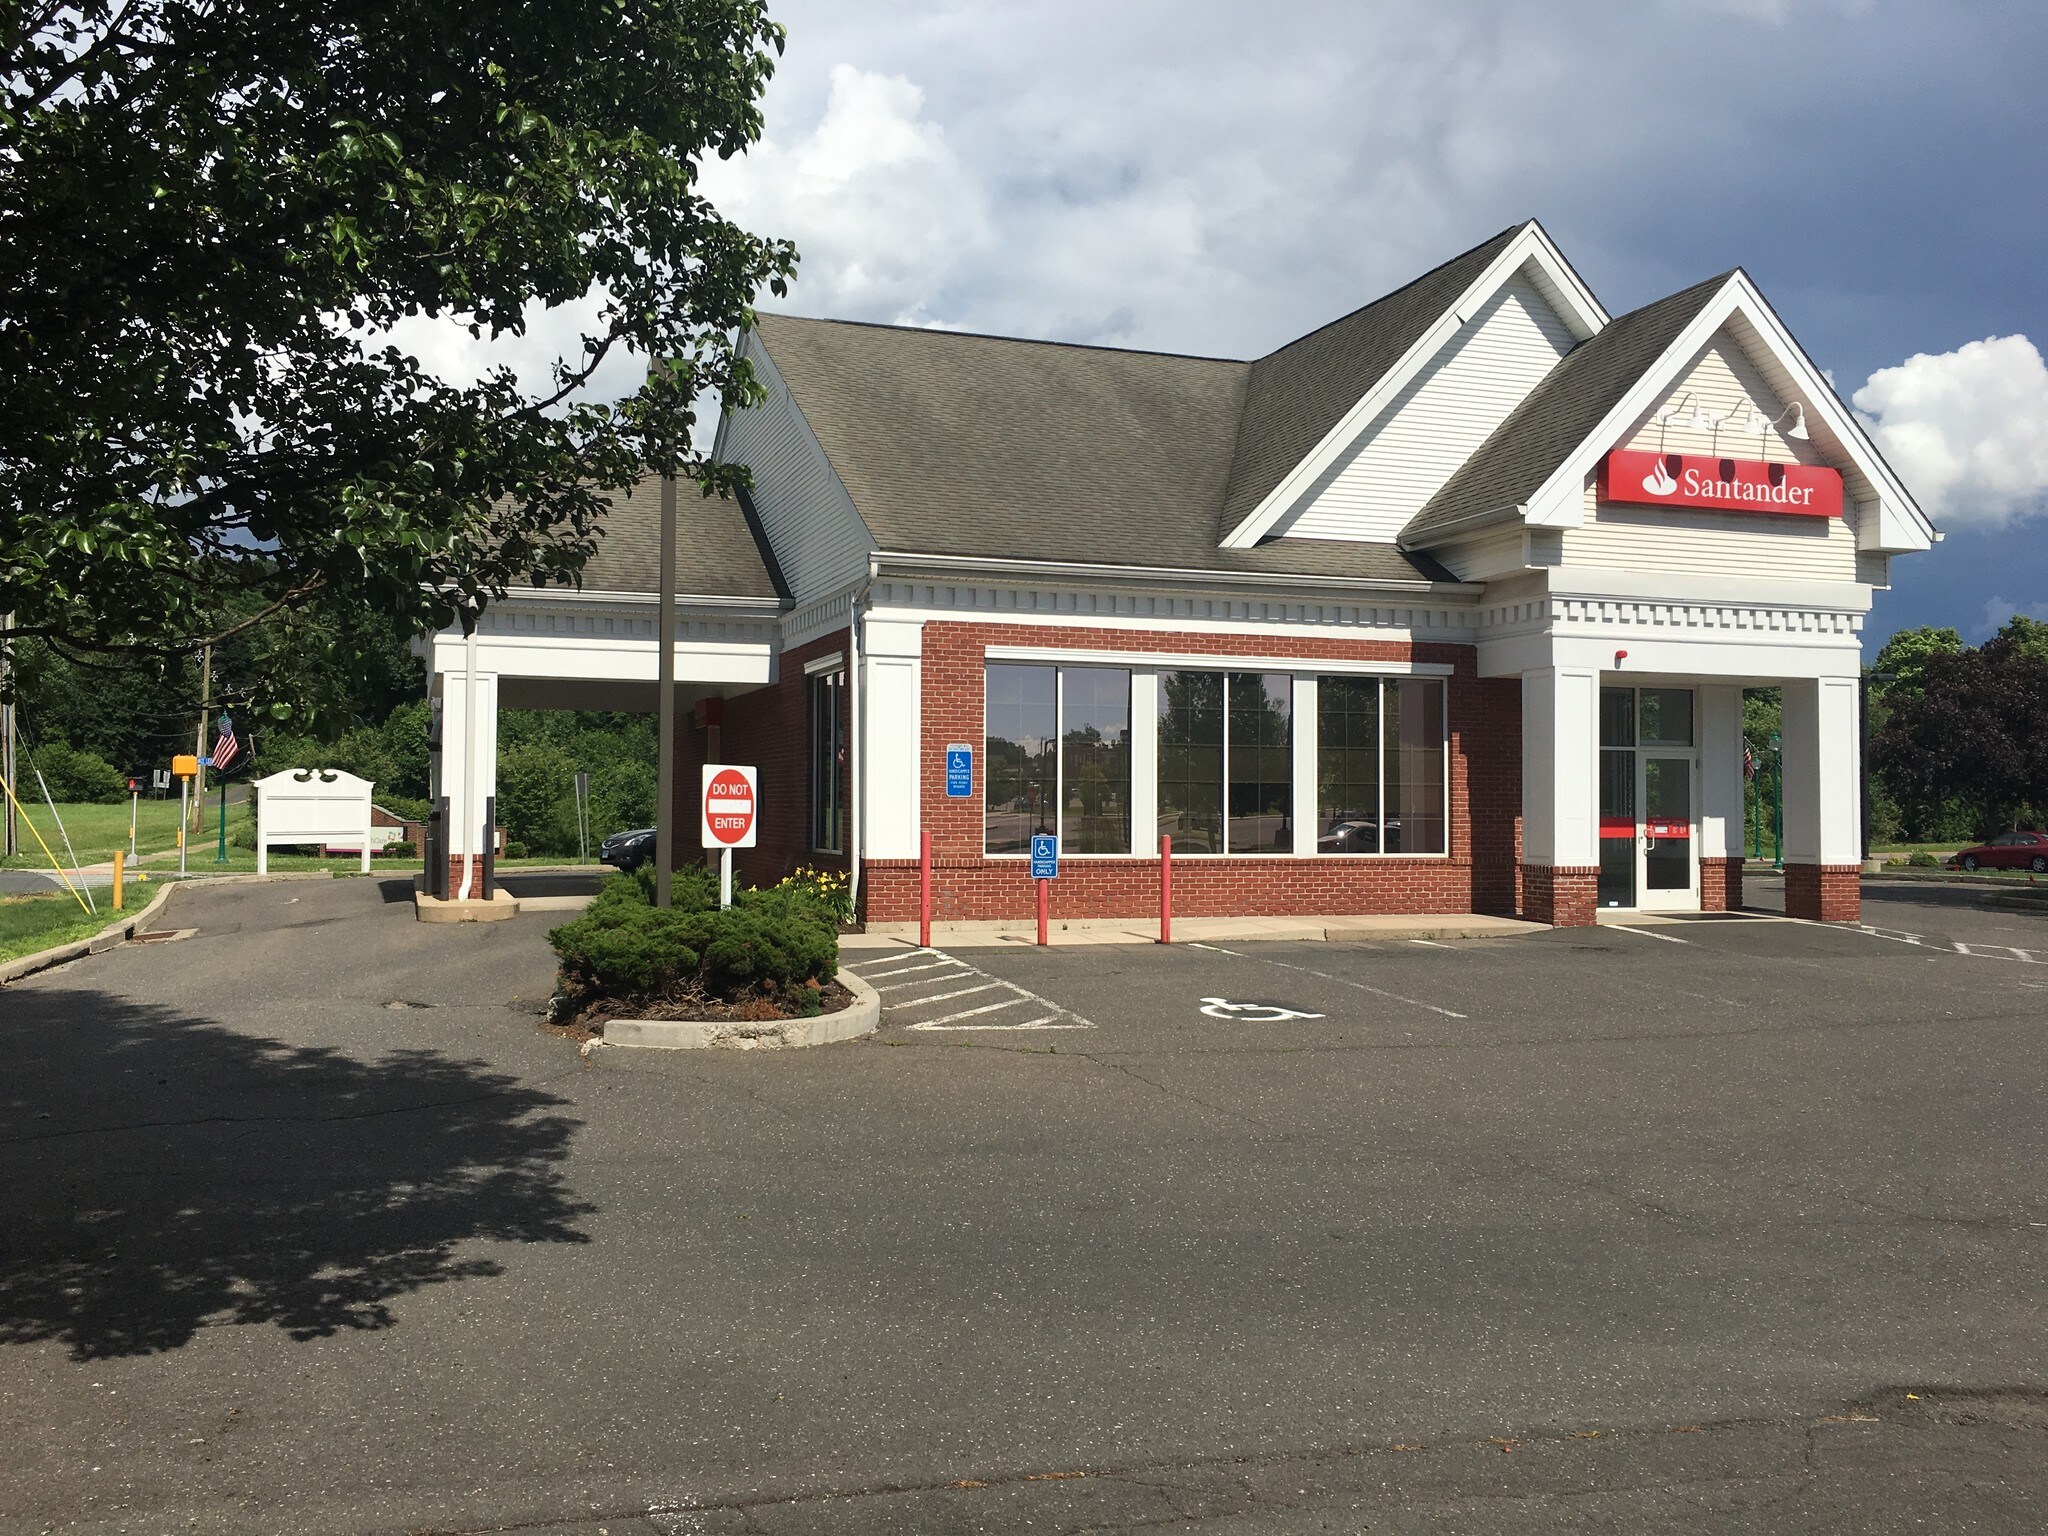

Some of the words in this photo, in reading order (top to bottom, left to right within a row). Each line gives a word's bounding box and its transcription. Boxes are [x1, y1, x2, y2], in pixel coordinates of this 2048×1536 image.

[1683, 468, 1814, 506] Santander
[712, 783, 727, 795] DO
[729, 784, 748, 795] NOT
[715, 817, 745, 829] ENTER
